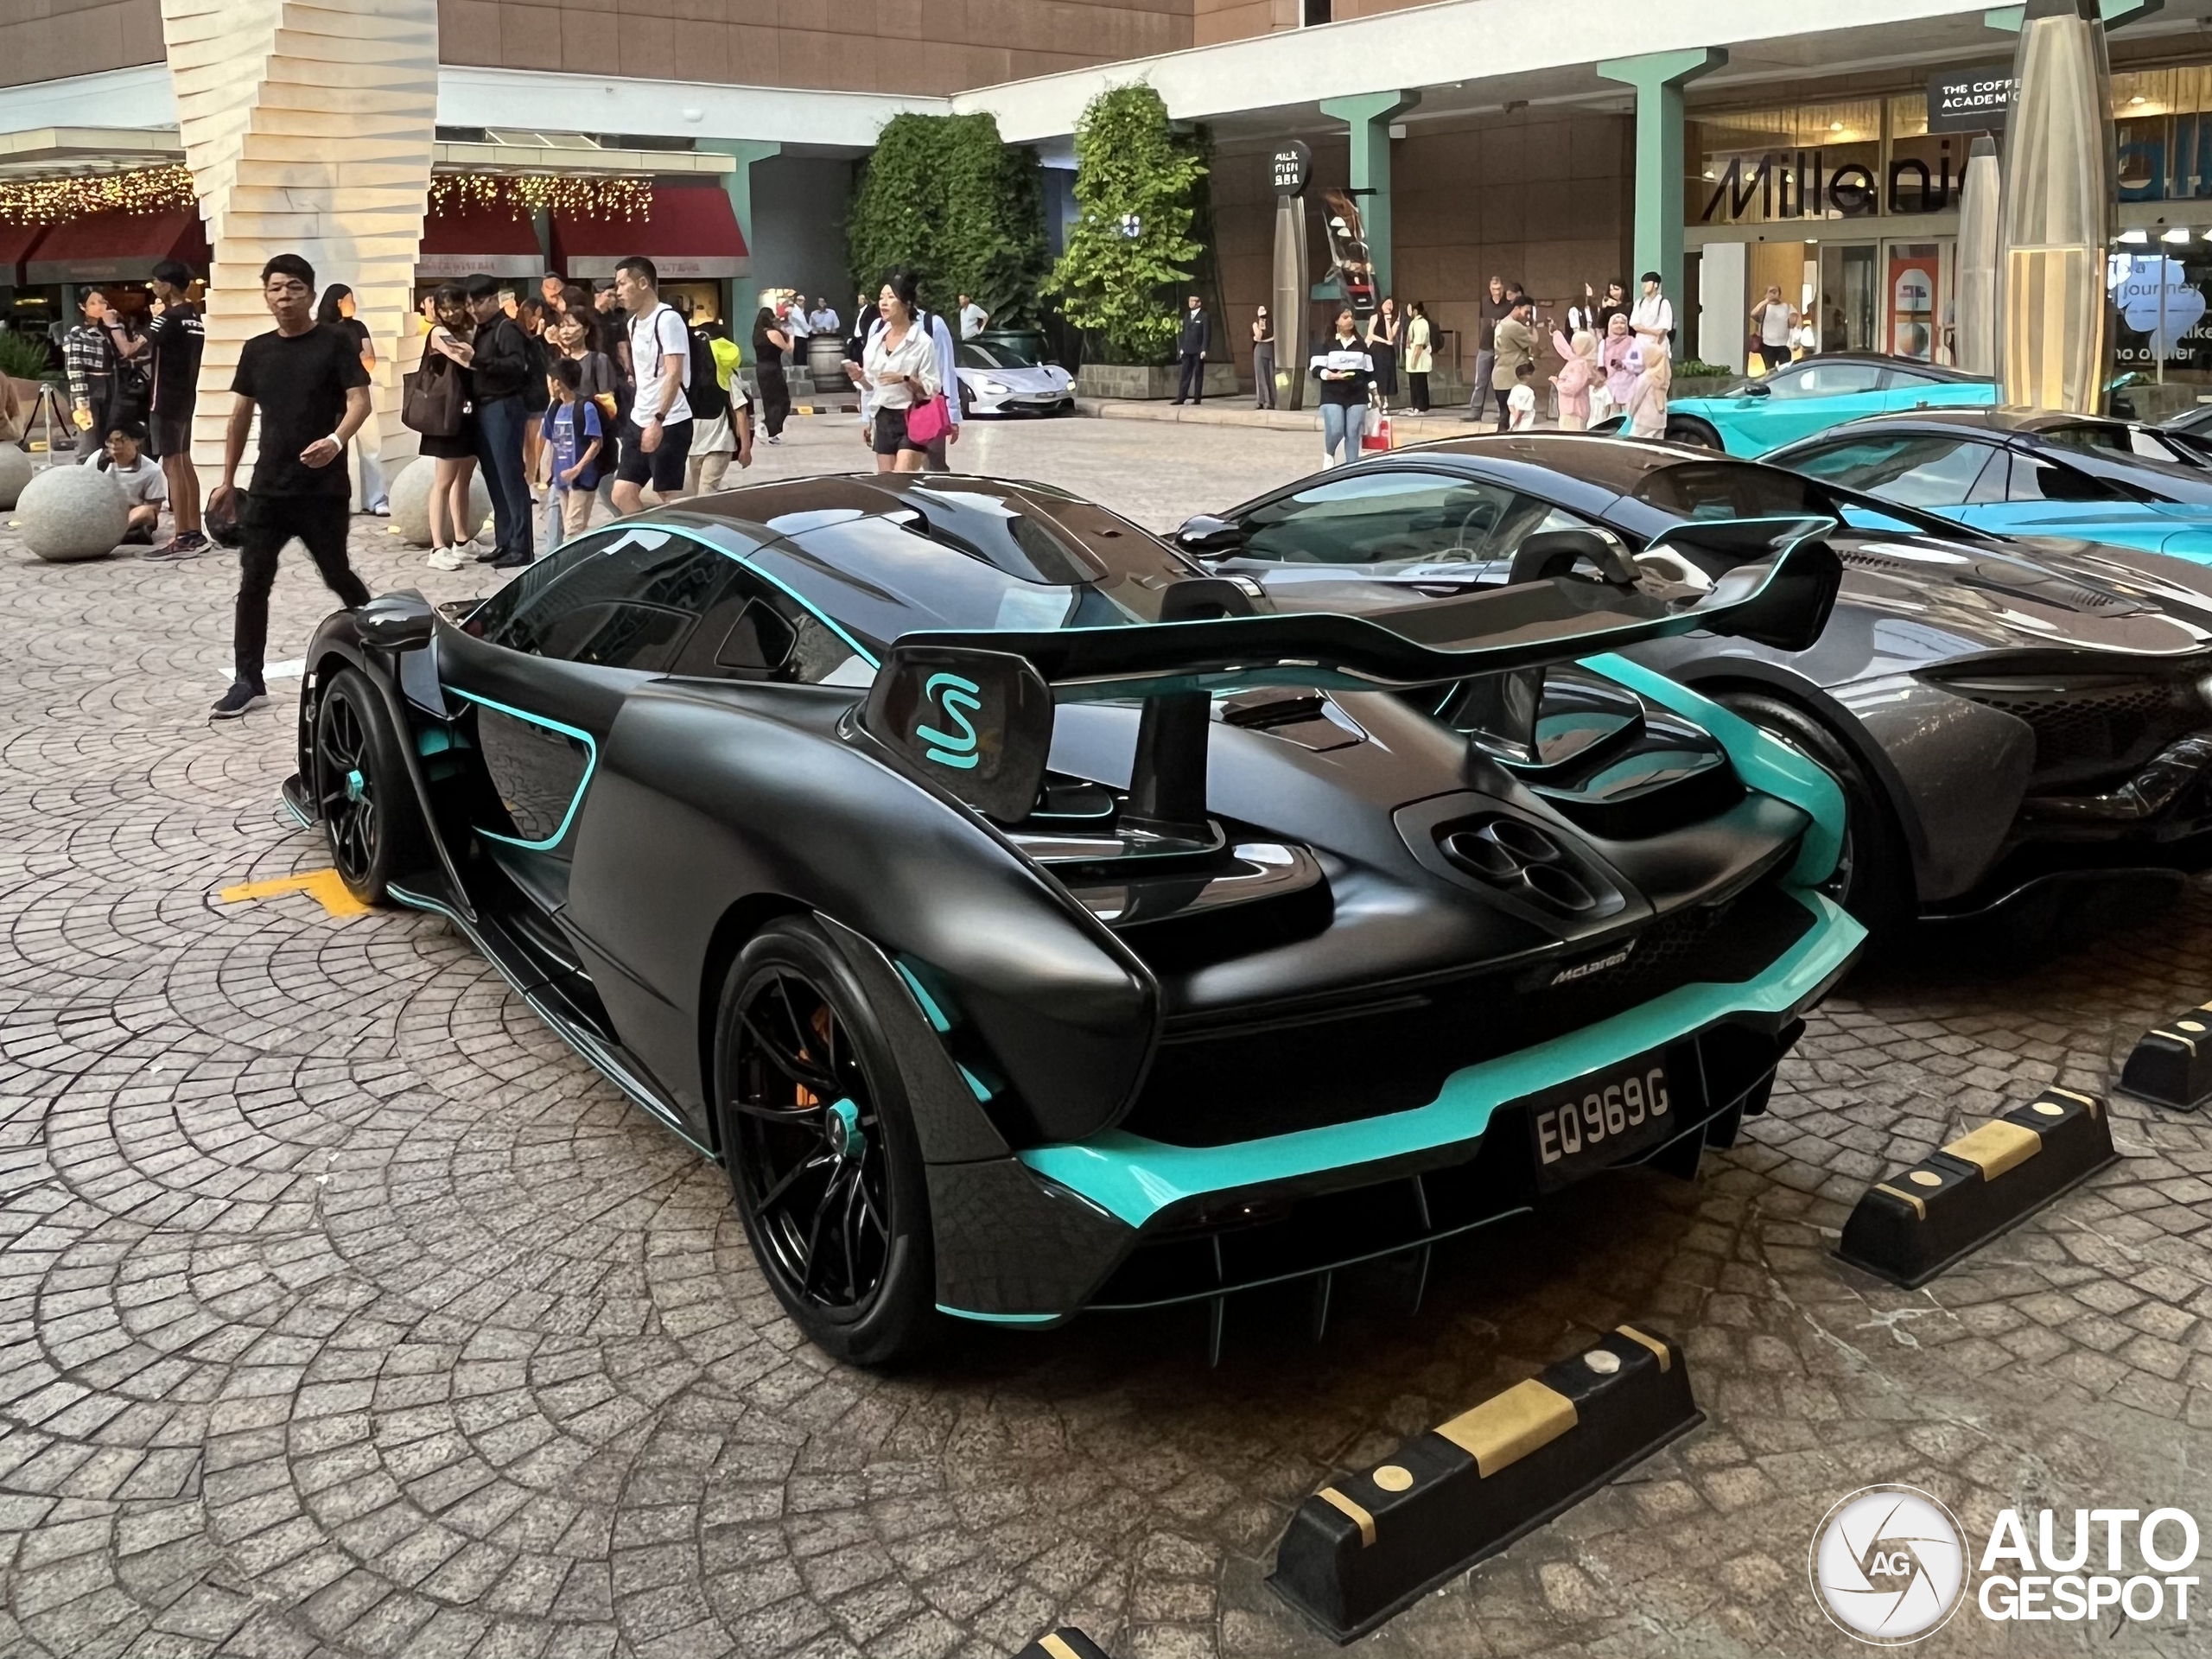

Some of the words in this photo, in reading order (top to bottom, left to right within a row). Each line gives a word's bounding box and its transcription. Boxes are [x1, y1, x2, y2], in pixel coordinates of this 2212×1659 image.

[1942, 84, 1967, 95] THE
[1973, 78, 2021, 92] COFFE
[1700, 139, 1968, 221] Milleni
[2122, 282, 2201, 300] journey
[1551, 949, 1630, 985] McLaren
[1536, 1067, 1669, 1165] EQ969G
